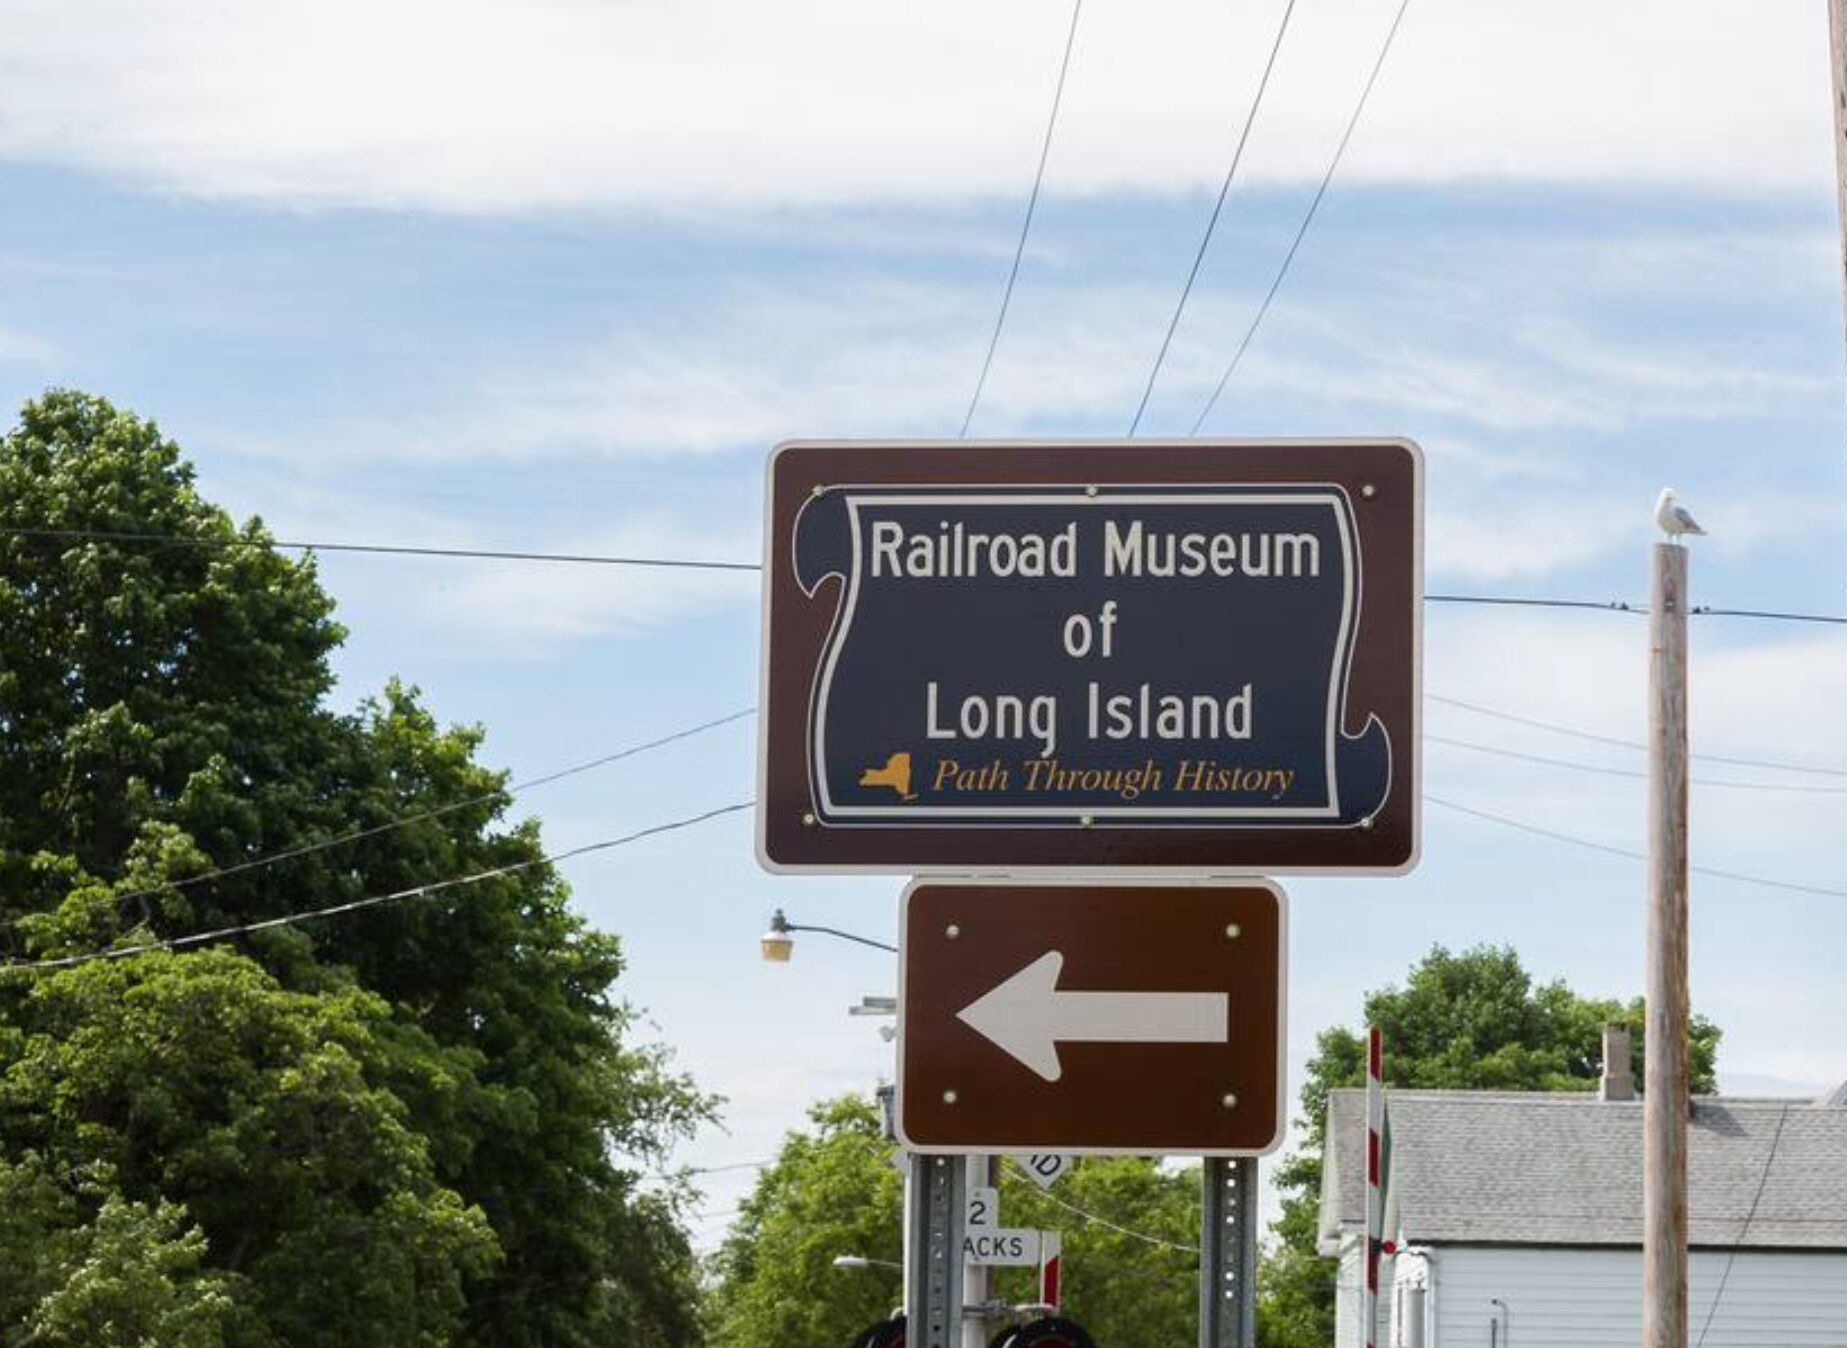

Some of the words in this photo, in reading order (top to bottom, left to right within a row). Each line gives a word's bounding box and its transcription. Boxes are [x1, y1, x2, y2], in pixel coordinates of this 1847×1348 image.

[872, 521, 1077, 577] Railroad
[1105, 521, 1320, 577] Museum
[1064, 601, 1117, 657] of
[926, 682, 1056, 757] Long
[1088, 683, 1252, 738] Island
[933, 760, 1009, 791] Path
[1023, 760, 1161, 798] Through
[1175, 760, 1295, 798] History
[1030, 1154, 1061, 1175] D
[969, 1201, 986, 1225] 2
